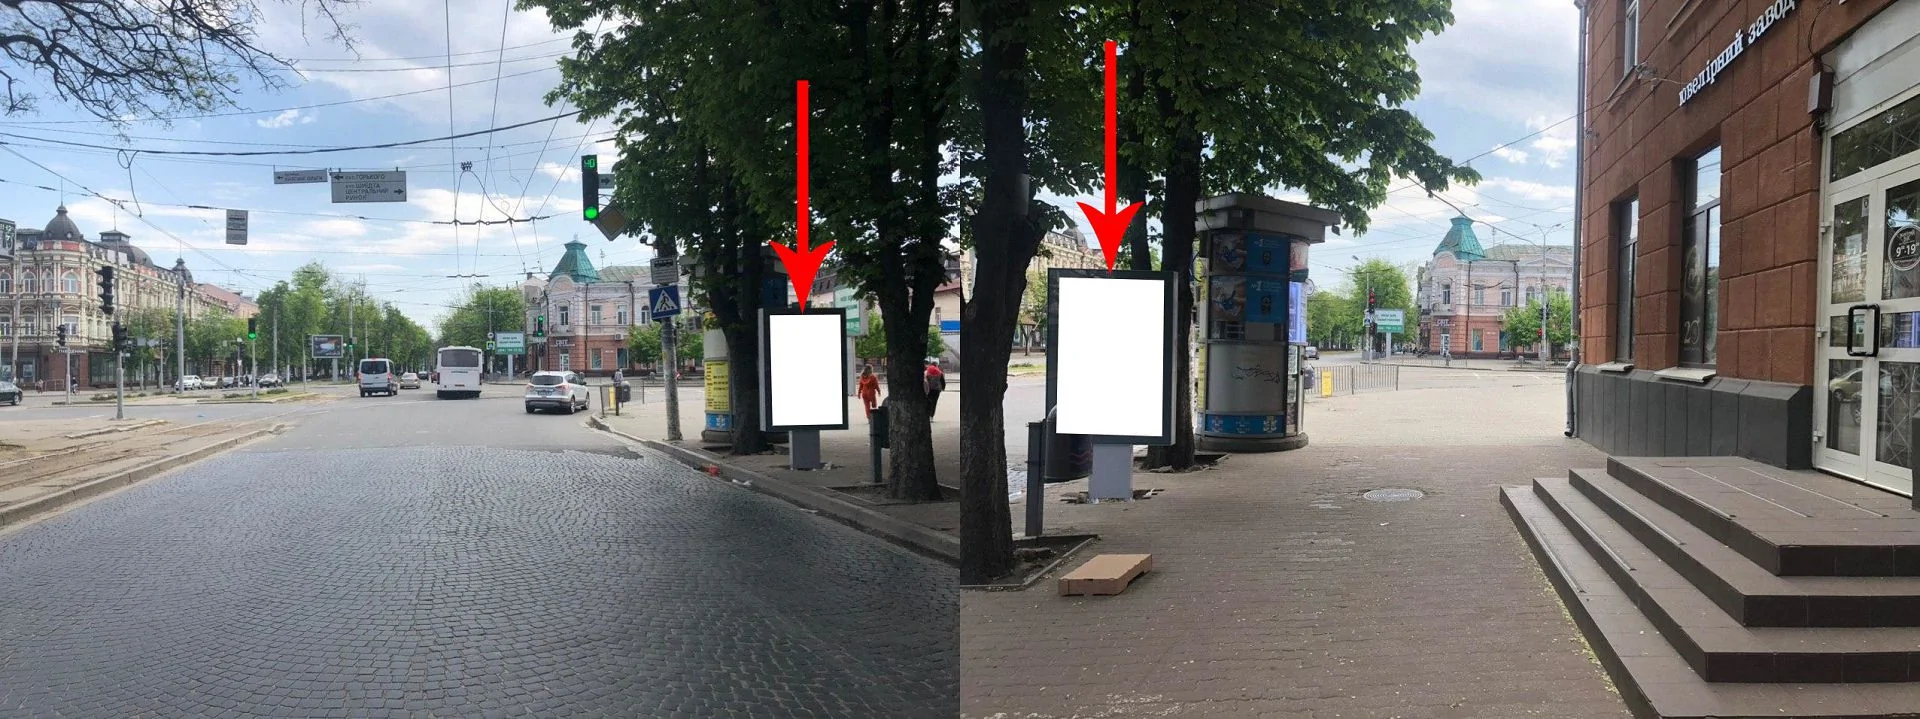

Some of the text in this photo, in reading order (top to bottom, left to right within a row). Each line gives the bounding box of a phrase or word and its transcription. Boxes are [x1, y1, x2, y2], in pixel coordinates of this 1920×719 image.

[1679, 0, 1795, 106] ювелірний завод
[583, 158, 596, 168] 40
